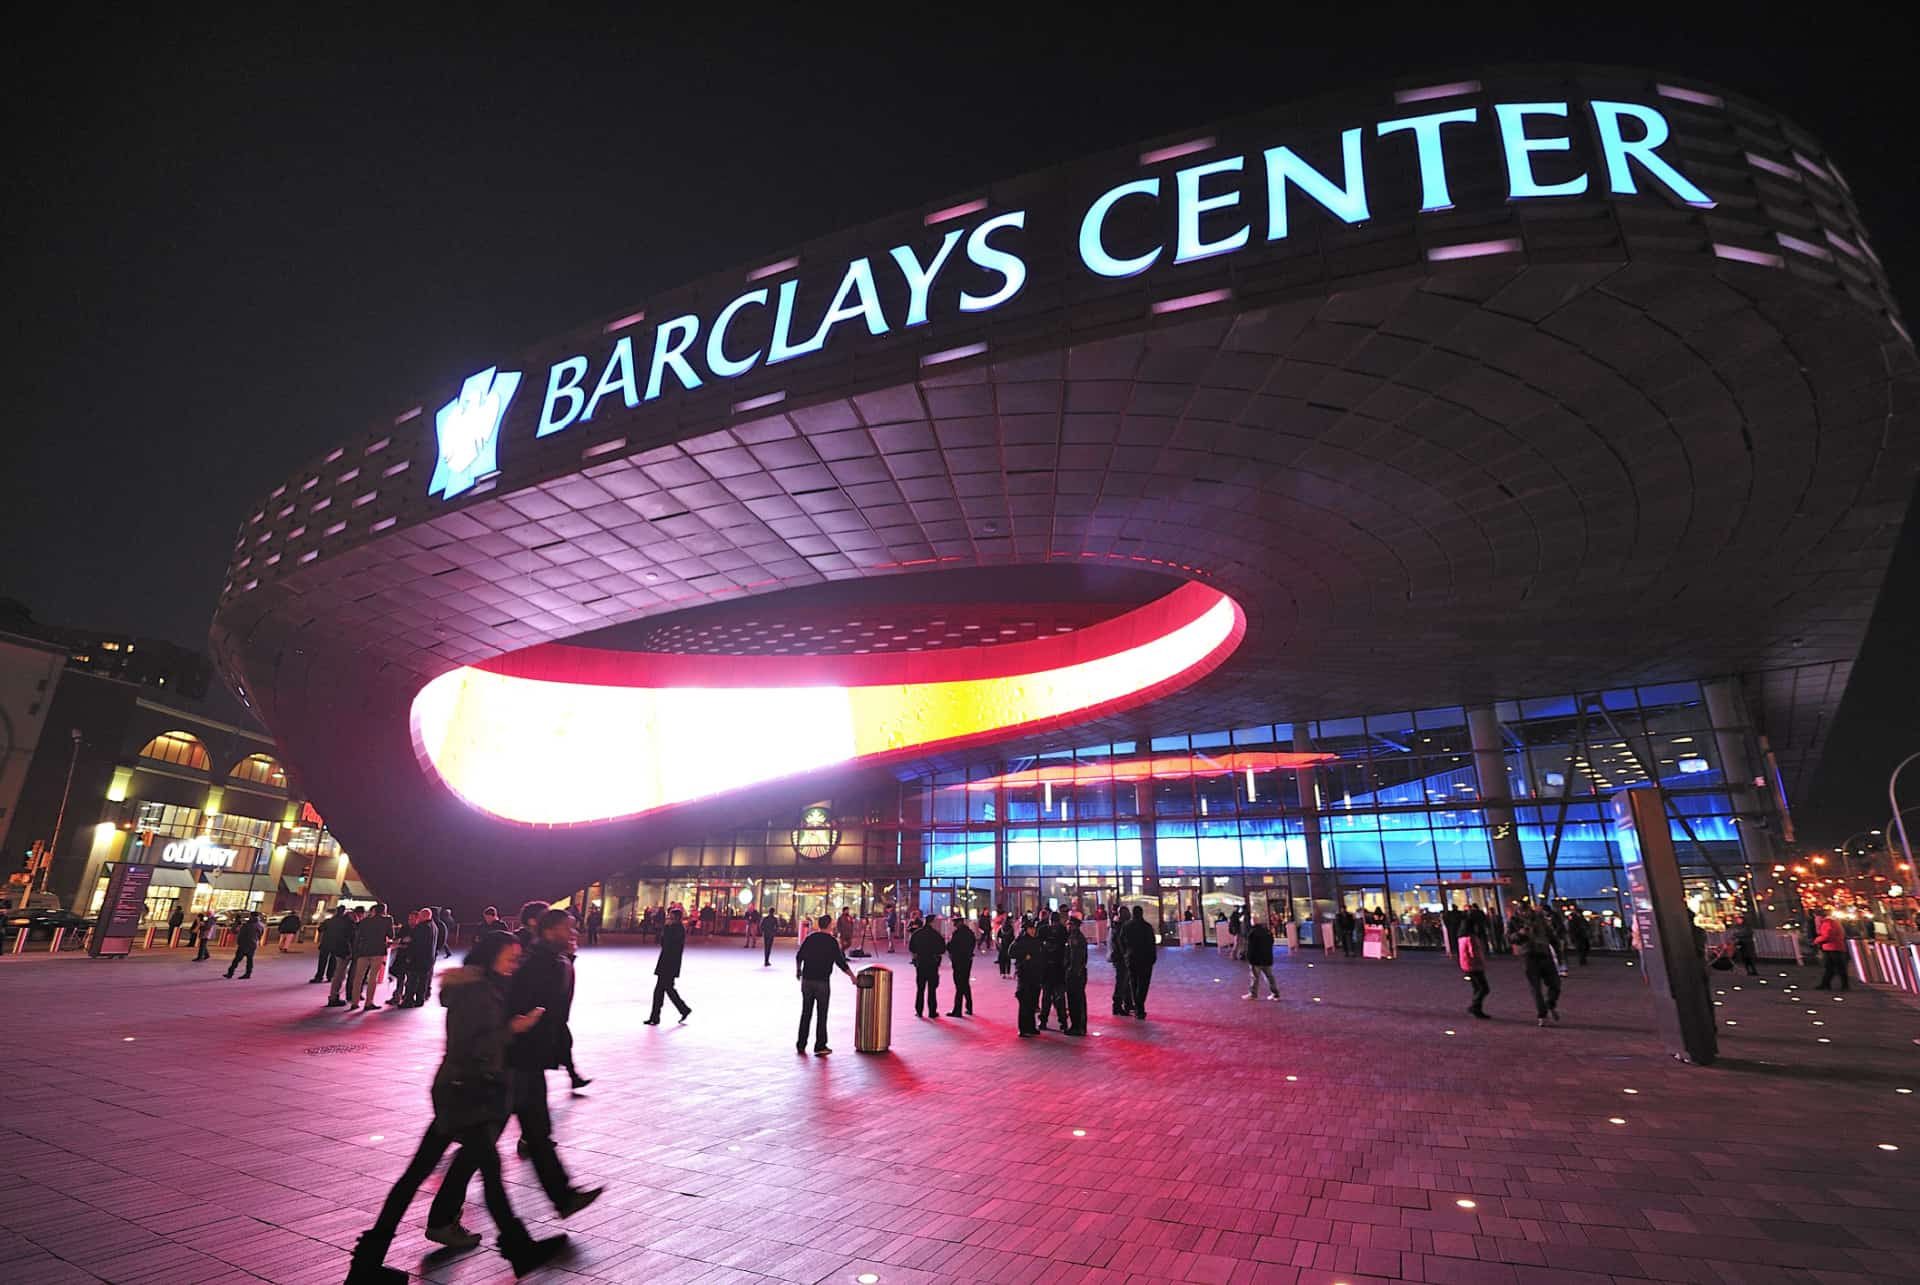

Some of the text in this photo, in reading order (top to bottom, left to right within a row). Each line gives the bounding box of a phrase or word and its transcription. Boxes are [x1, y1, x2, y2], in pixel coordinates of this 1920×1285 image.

[535, 100, 1717, 439] BARCLAYS CENTER
[163, 842, 198, 863] OLD
